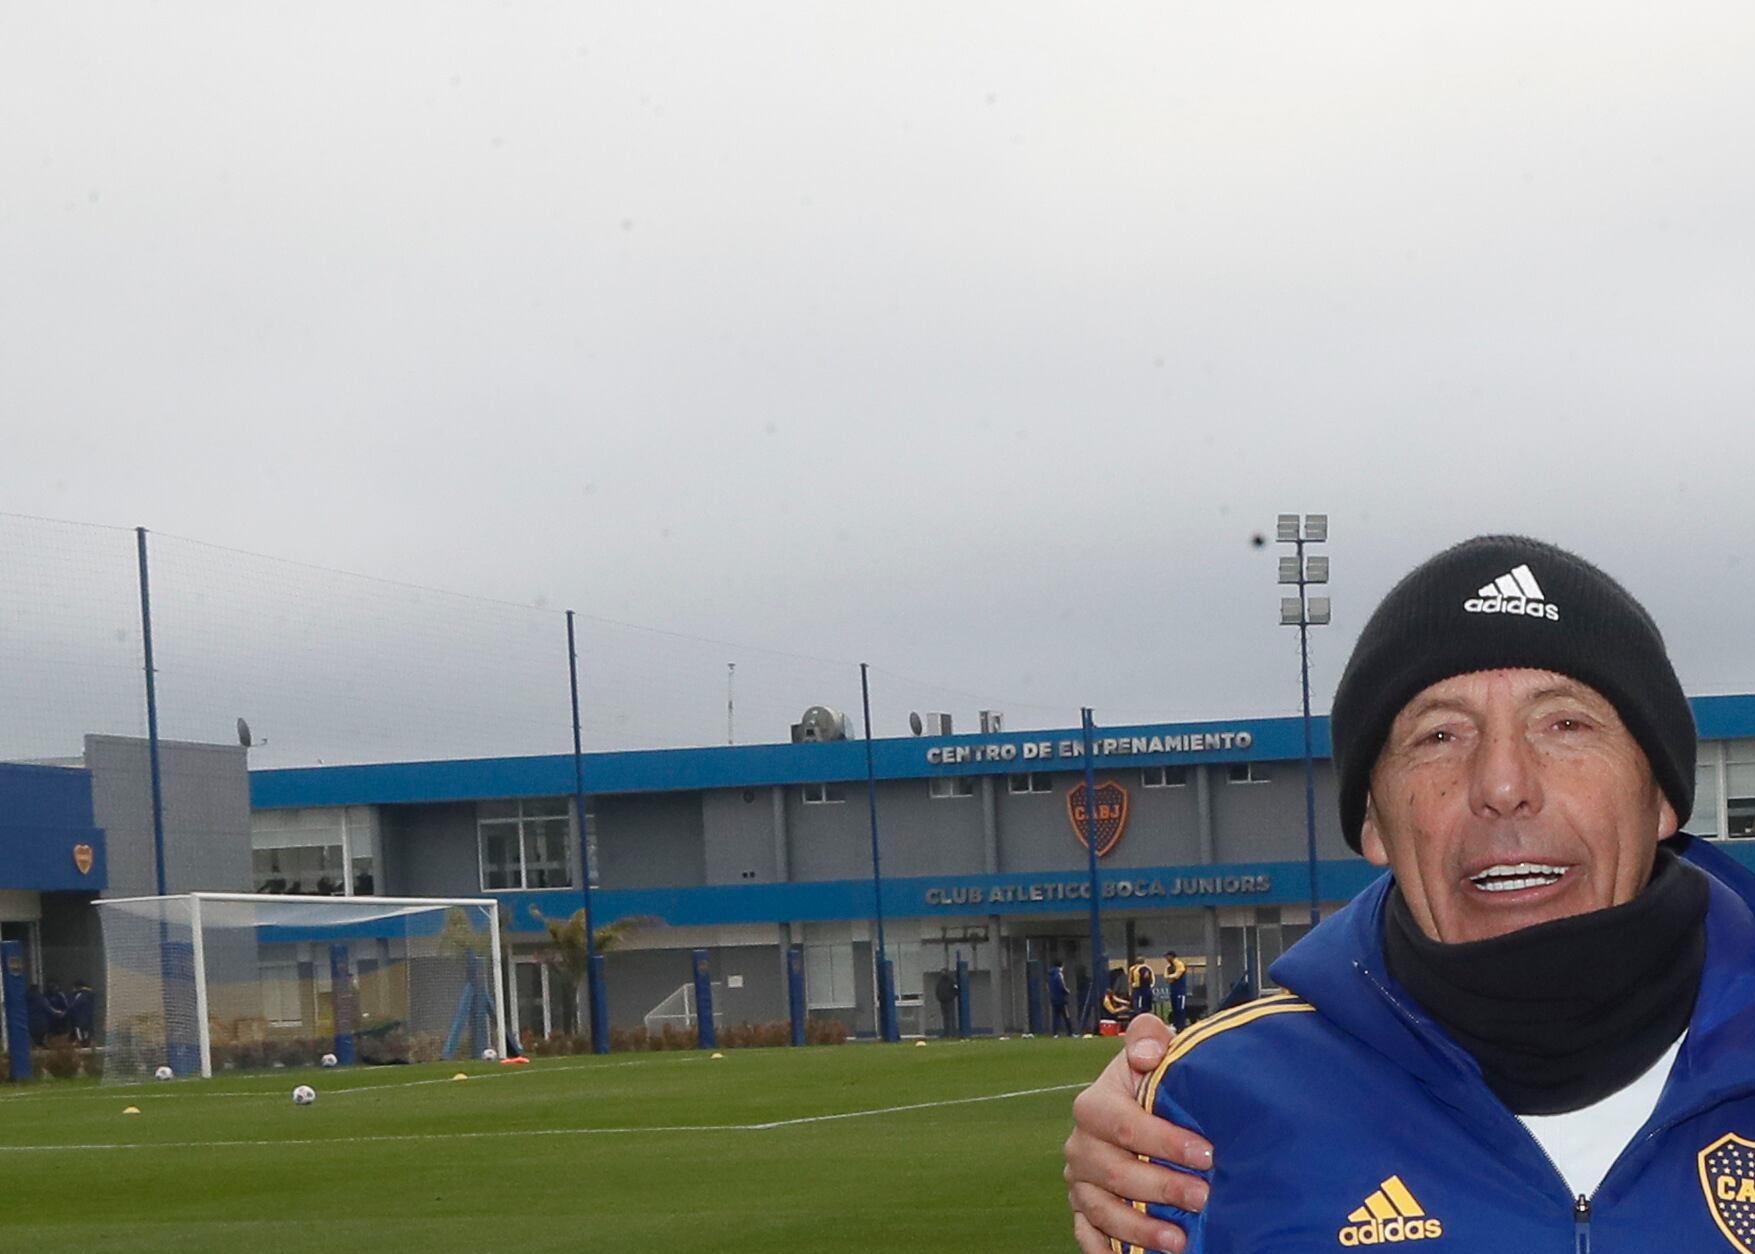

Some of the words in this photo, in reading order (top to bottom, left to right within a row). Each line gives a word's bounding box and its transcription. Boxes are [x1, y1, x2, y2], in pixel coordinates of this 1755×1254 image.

[1464, 594, 1559, 621] adidas
[927, 743, 1016, 764] CENTRO
[1023, 742, 1053, 759] DE
[1059, 731, 1252, 757] ENTRENAMIENTO
[926, 886, 983, 905] CLUB
[1103, 879, 1166, 899] BOCA
[1170, 875, 1271, 896] JUNIORS
[1338, 1216, 1443, 1248] adidas
